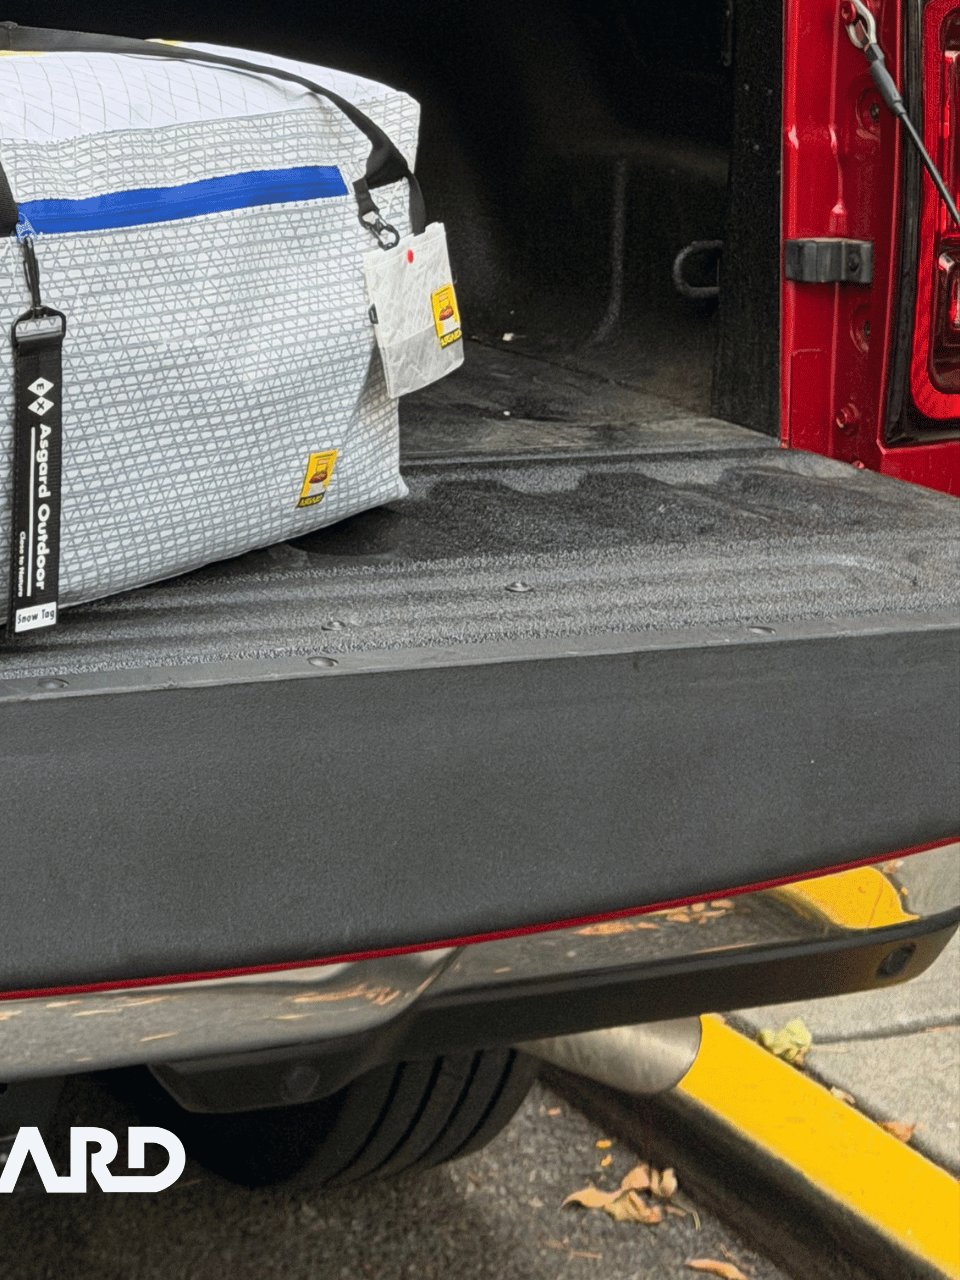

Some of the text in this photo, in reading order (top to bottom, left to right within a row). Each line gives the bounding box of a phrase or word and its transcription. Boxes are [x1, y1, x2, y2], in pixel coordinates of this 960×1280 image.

[35, 423, 52, 590] Asgard Outdoor
[17, 608, 55, 625] Snow Tag
